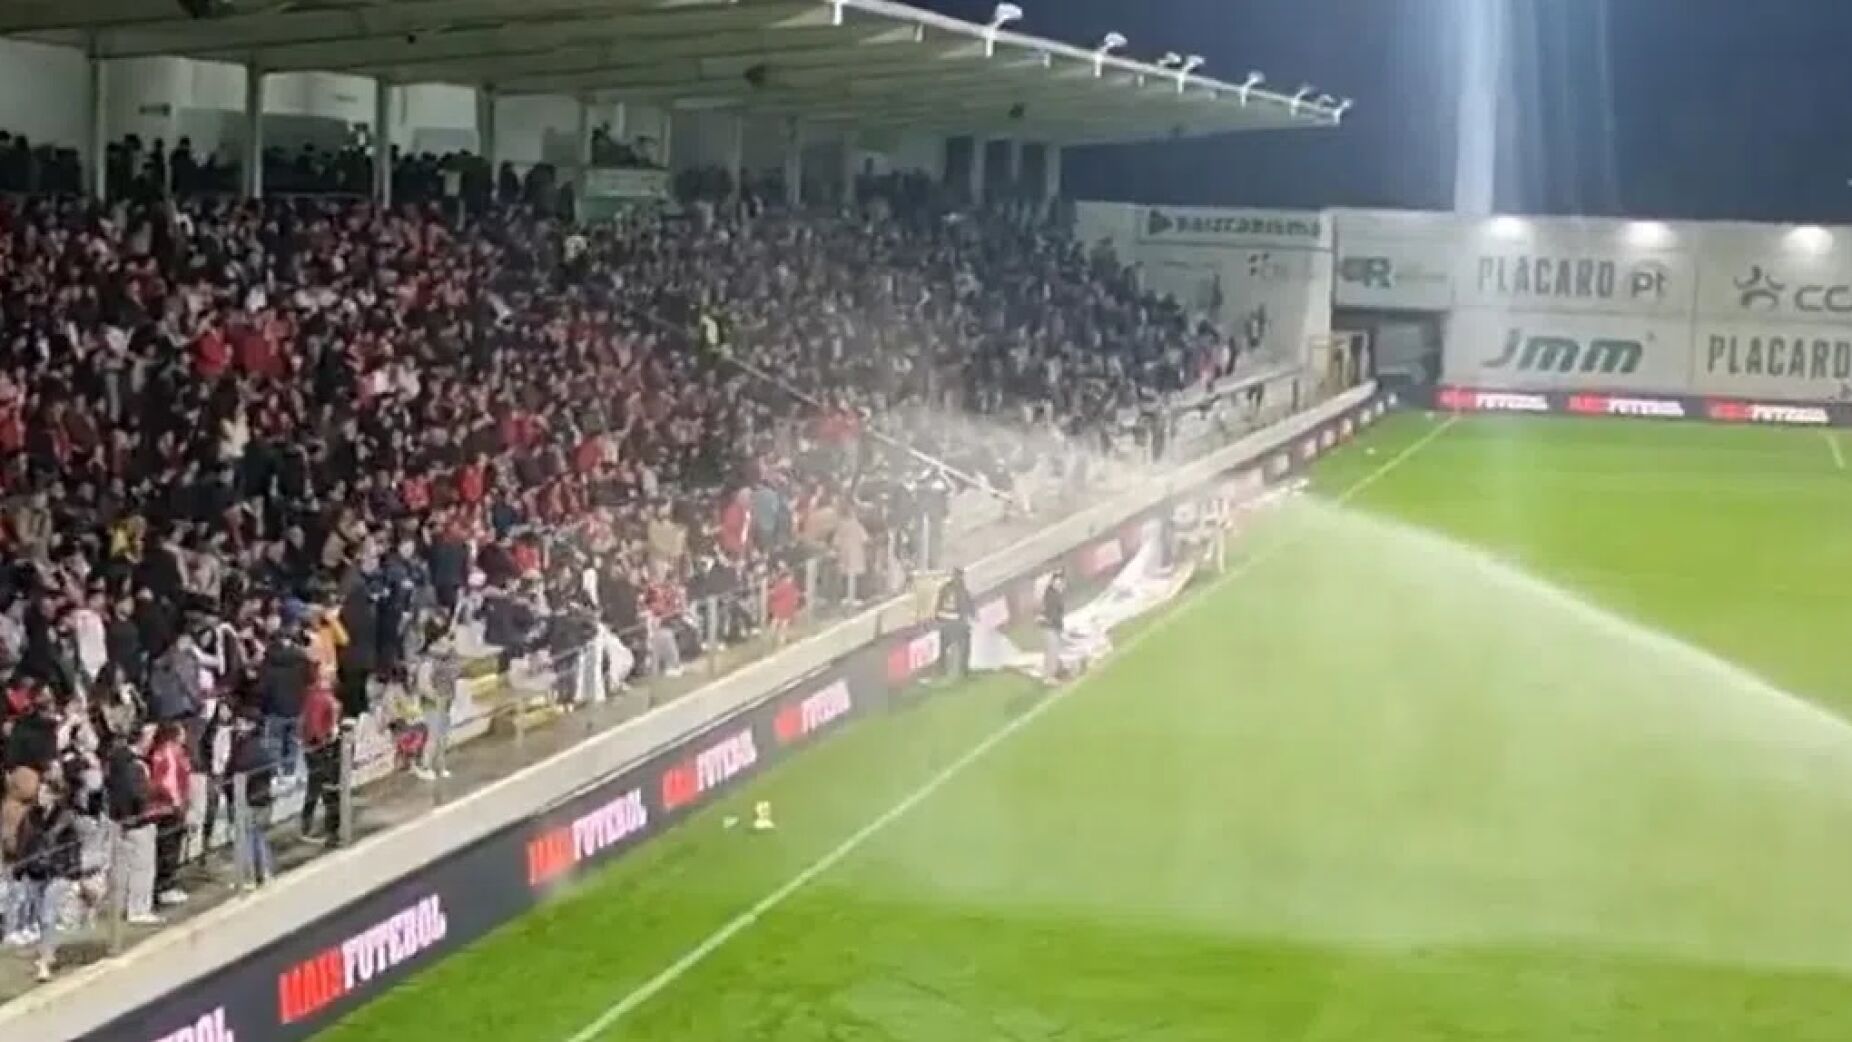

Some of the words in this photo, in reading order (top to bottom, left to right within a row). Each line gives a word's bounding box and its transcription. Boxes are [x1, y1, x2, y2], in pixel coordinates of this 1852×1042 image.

[1477, 255, 1615, 298] PLACARD
[1707, 333, 1850, 380] PLACARD
[279, 893, 447, 1024] MAISFUTEBOL
